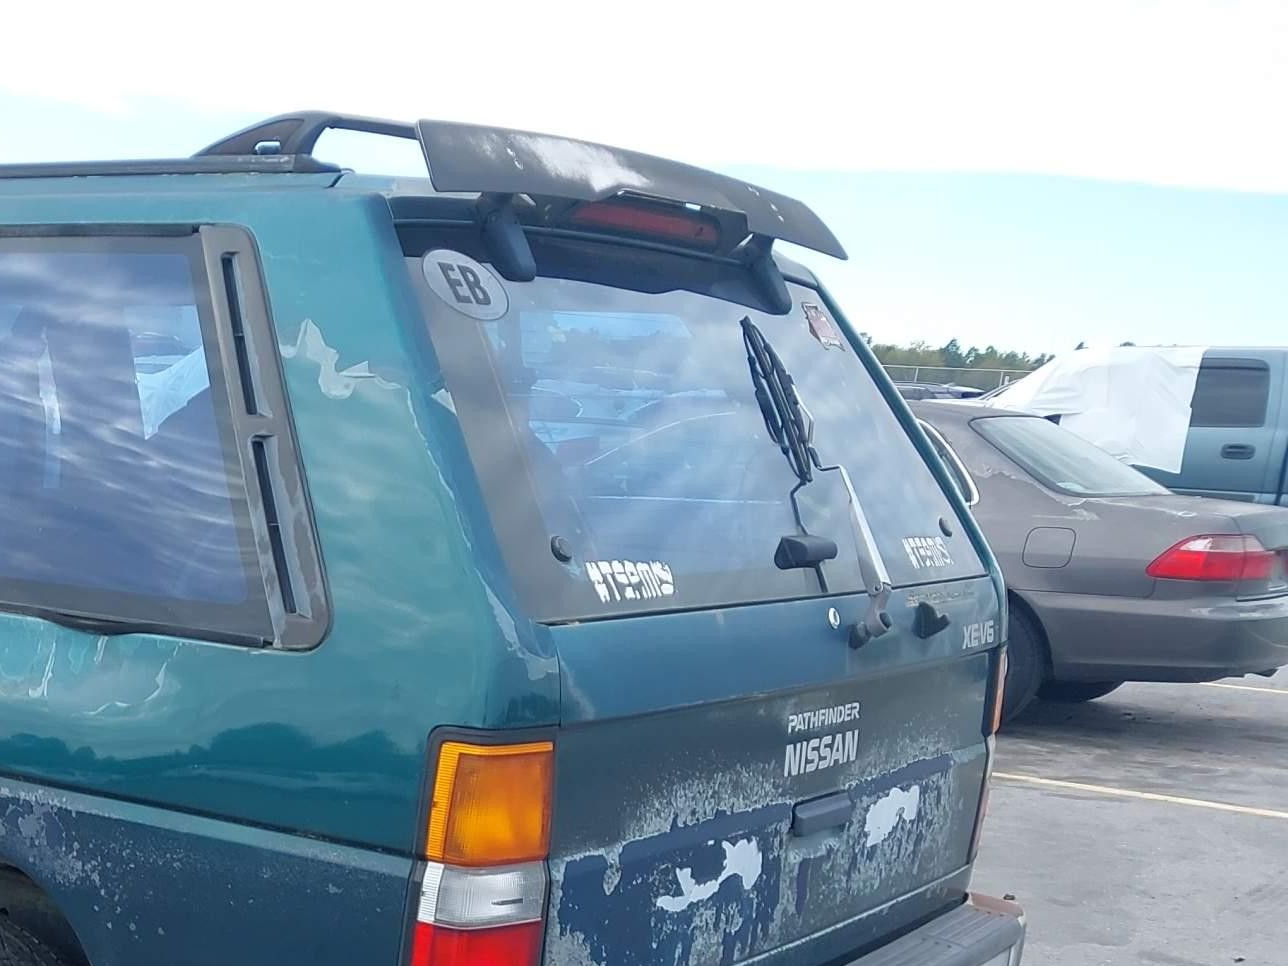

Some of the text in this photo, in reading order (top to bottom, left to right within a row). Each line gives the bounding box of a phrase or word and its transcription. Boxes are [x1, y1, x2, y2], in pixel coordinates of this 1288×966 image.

[436, 261, 492, 306] EB
[787, 702, 860, 734] PATHFINDER
[783, 728, 860, 778] NISSAN
